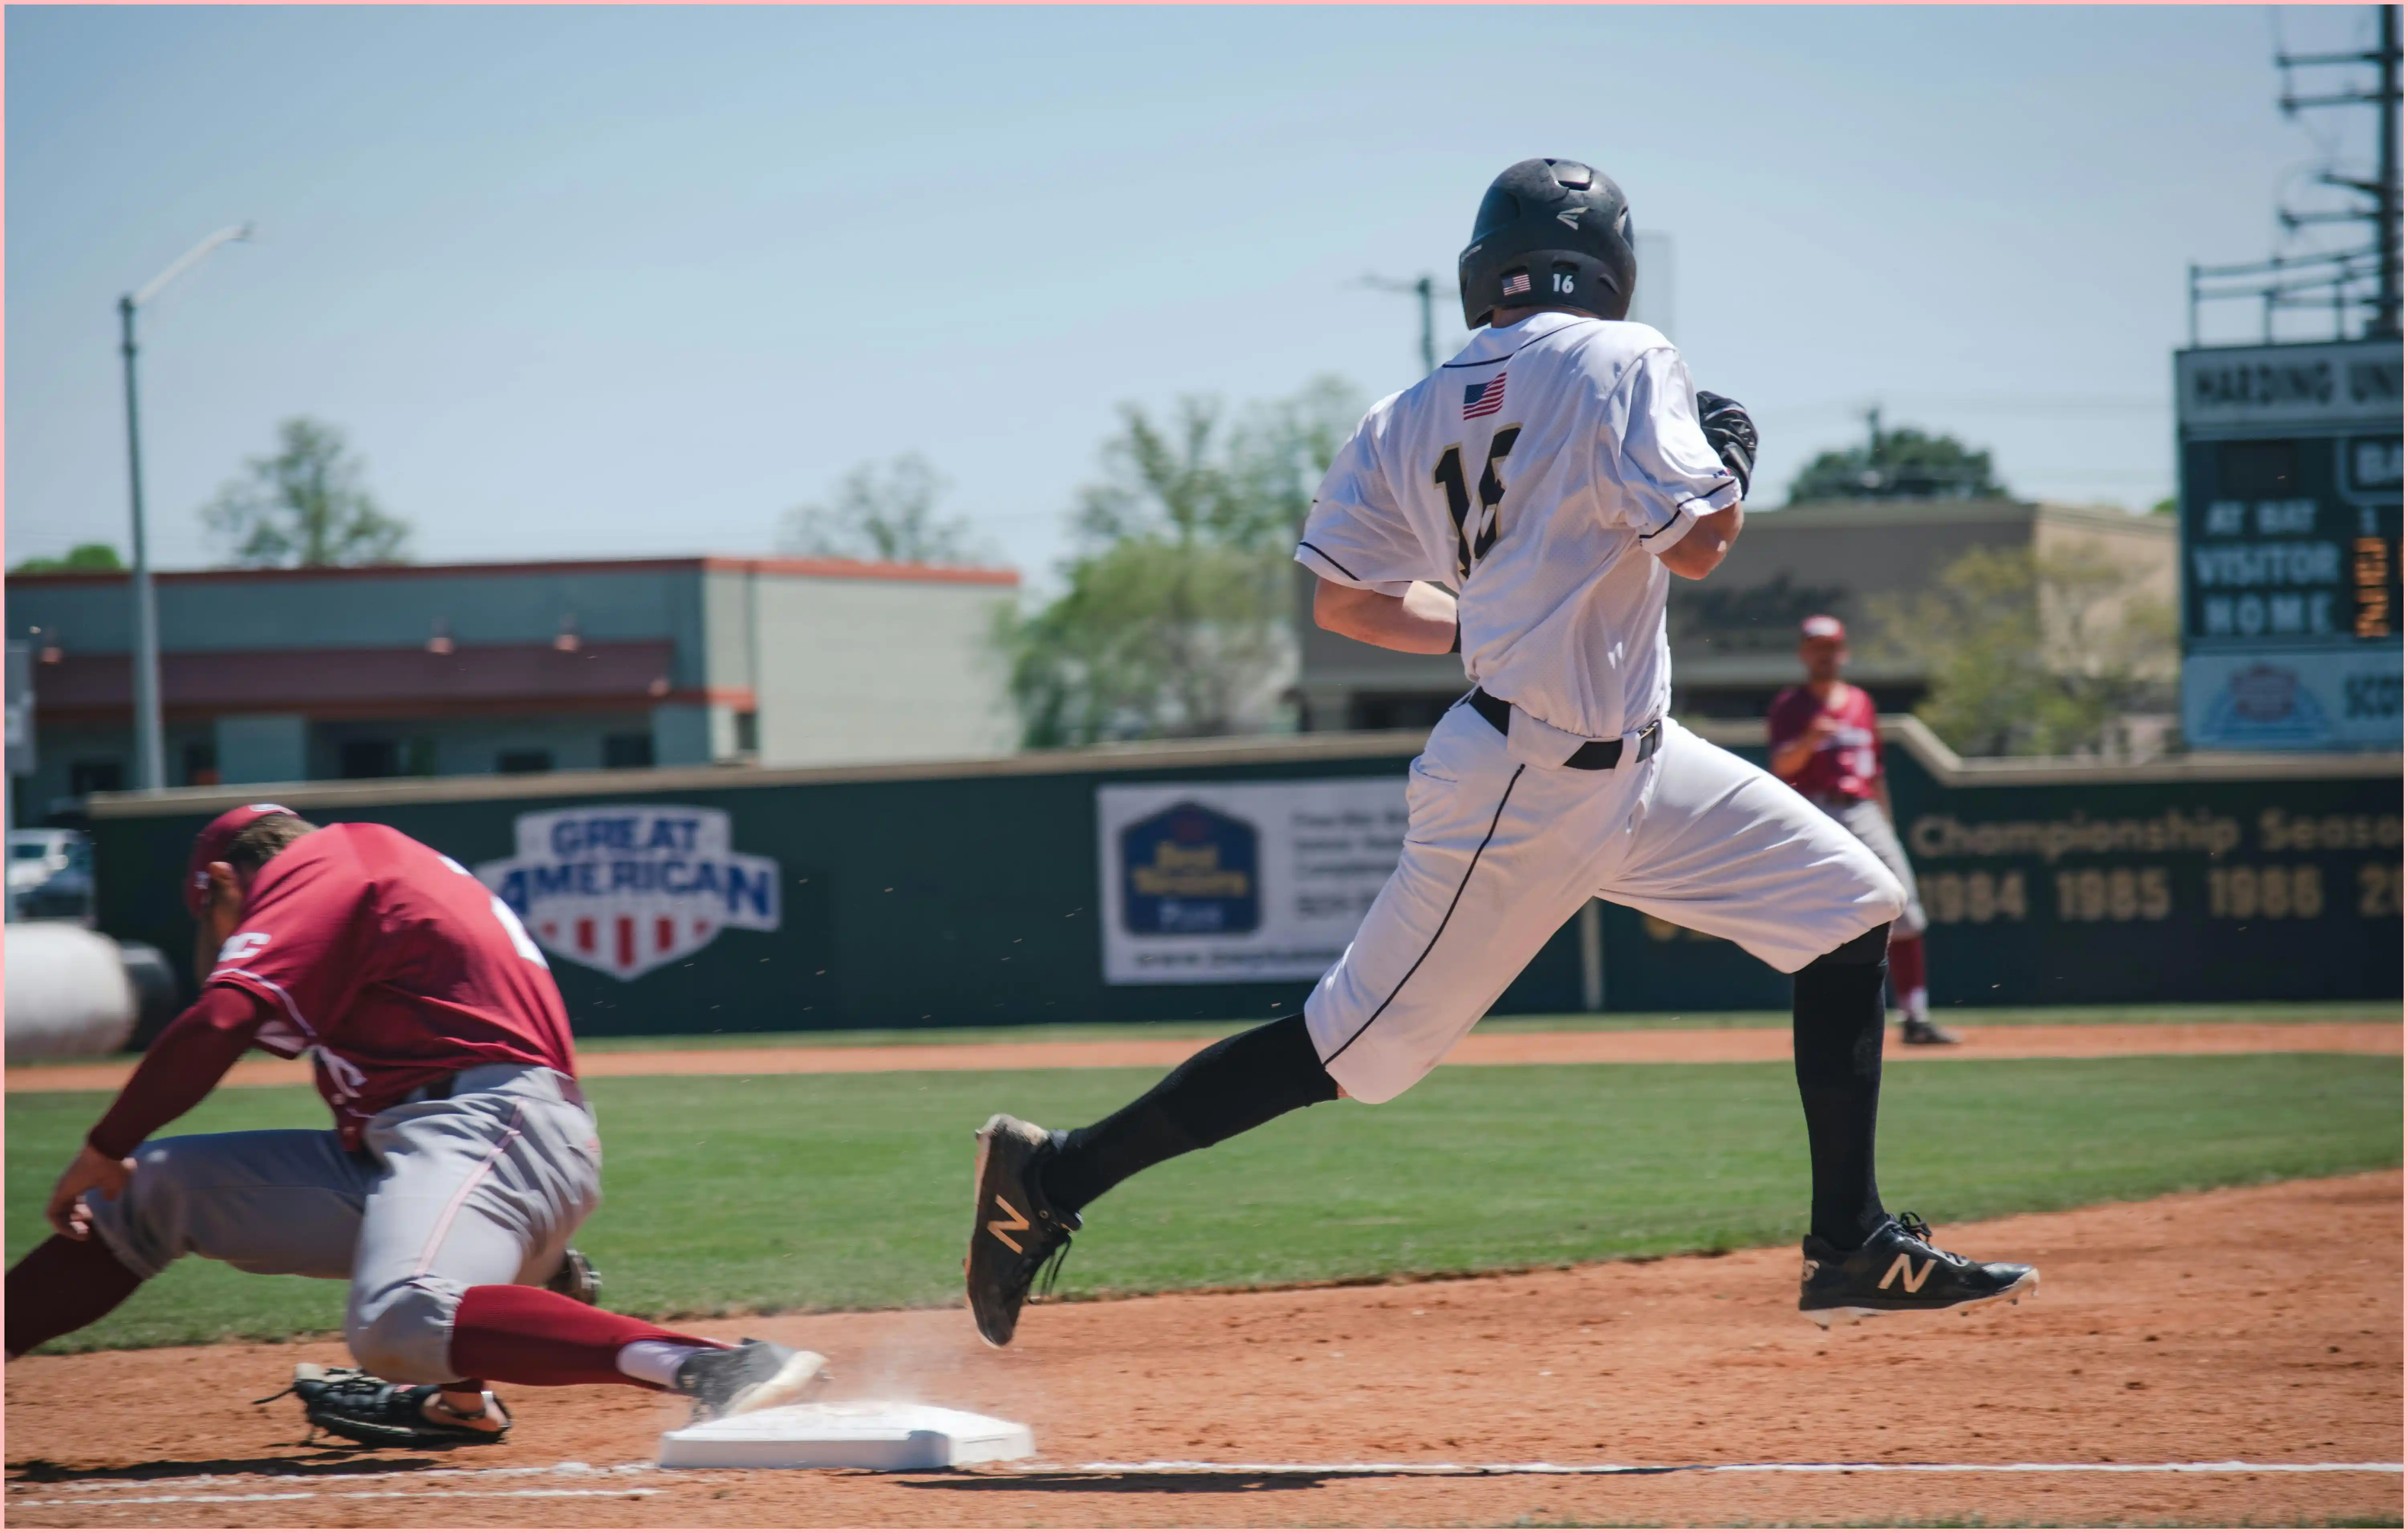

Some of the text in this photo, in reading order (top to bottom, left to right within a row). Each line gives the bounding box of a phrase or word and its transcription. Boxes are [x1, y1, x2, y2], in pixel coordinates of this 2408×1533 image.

[1553, 274, 1574, 293] 16
[2195, 363, 2335, 404] HARDING
[2208, 499, 2316, 535] AT BAT
[2194, 541, 2339, 586] VISITOR
[2206, 594, 2333, 634] HOME
[550, 816, 699, 857] GREAT
[1911, 808, 2242, 864] Championship
[501, 862, 771, 917] AMERICAN
[1921, 871, 2027, 923] 1984
[2055, 869, 2170, 921] 1985
[2209, 867, 2323, 920] 1986
[1878, 1253, 1938, 1293] N
